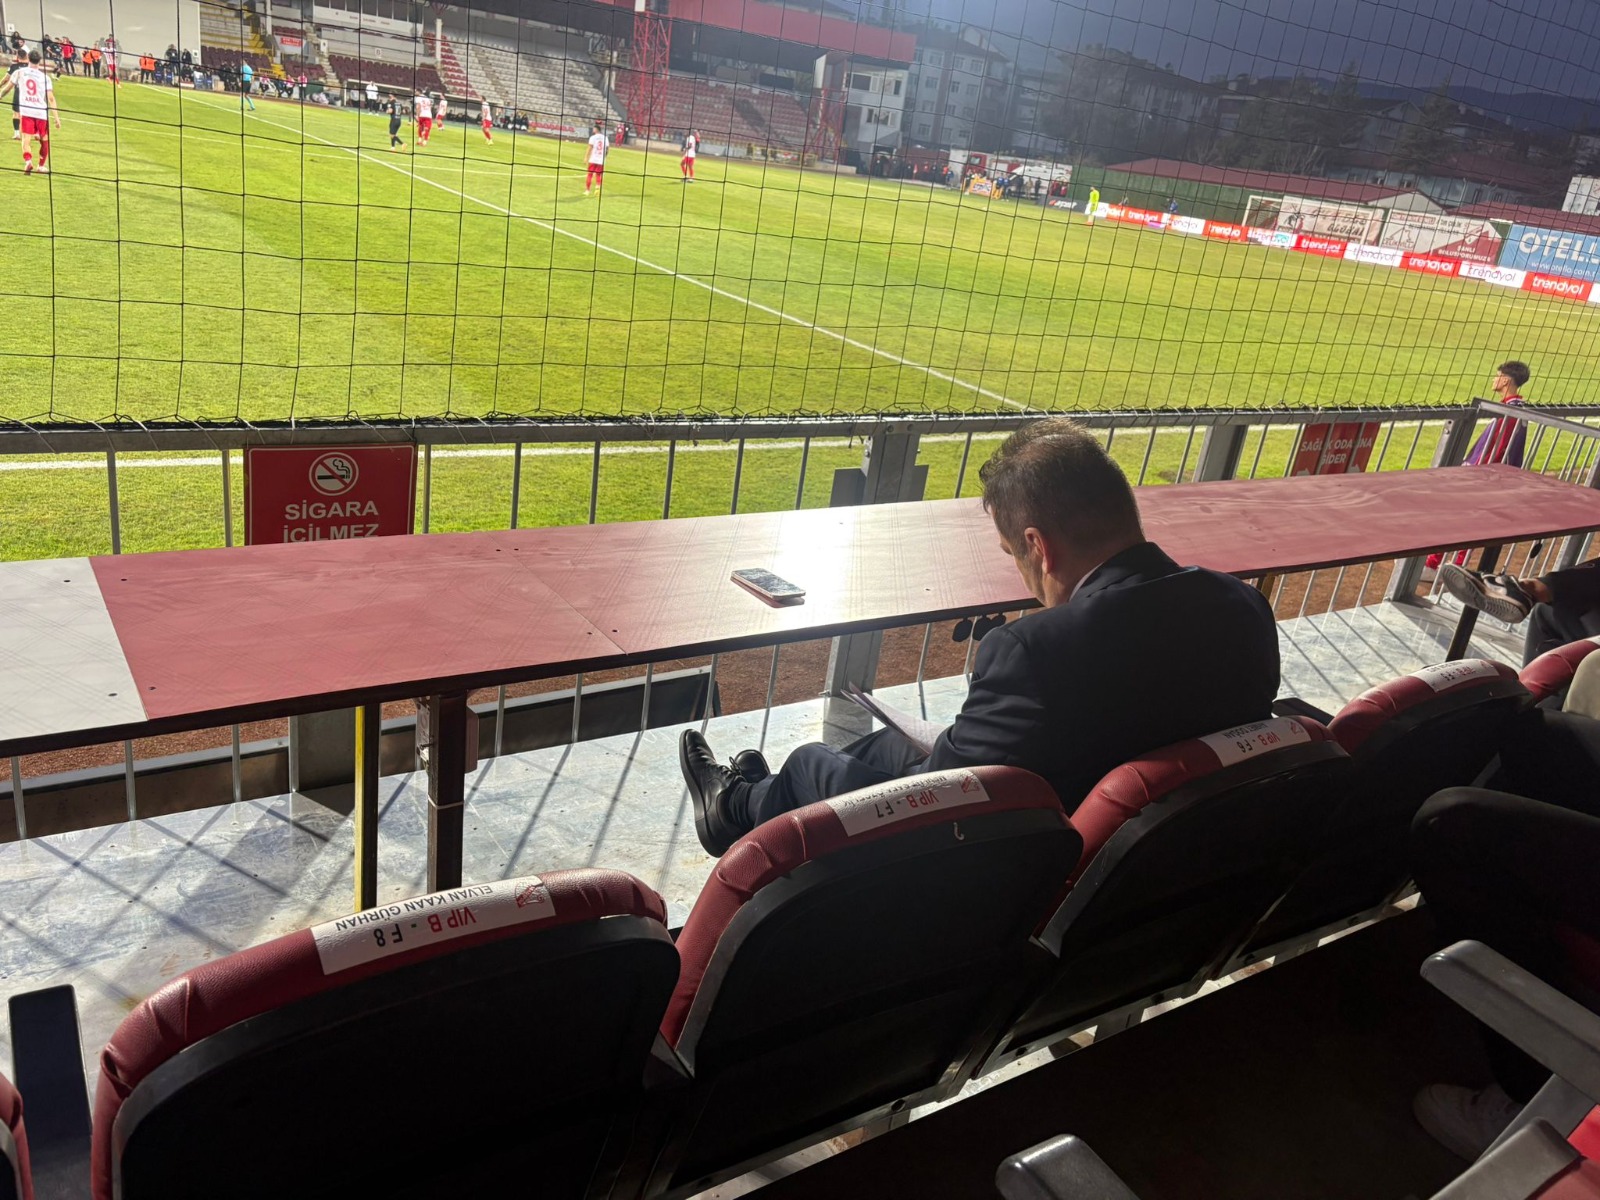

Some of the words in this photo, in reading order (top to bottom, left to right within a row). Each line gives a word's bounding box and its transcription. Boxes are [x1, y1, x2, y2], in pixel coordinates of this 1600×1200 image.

[26, 79, 37, 96] 9
[1301, 239, 1341, 254] trendyol
[1353, 246, 1395, 262] trendyol
[1408, 257, 1454, 272] trendyol
[1467, 265, 1517, 282] trendyol
[1532, 276, 1585, 295] trendyol
[1301, 438, 1332, 451] SAĞLK
[1334, 437, 1372, 449] ODAINA
[284, 500, 378, 520] SİGARA
[906, 794, 918, 808] B
[920, 789, 940, 807] VIP
[450, 885, 494, 903] ELVAN
[403, 895, 447, 912] KAAN
[335, 906, 402, 932] GÜRHAN
[426, 913, 443, 933] B
[449, 906, 477, 930] VIP
